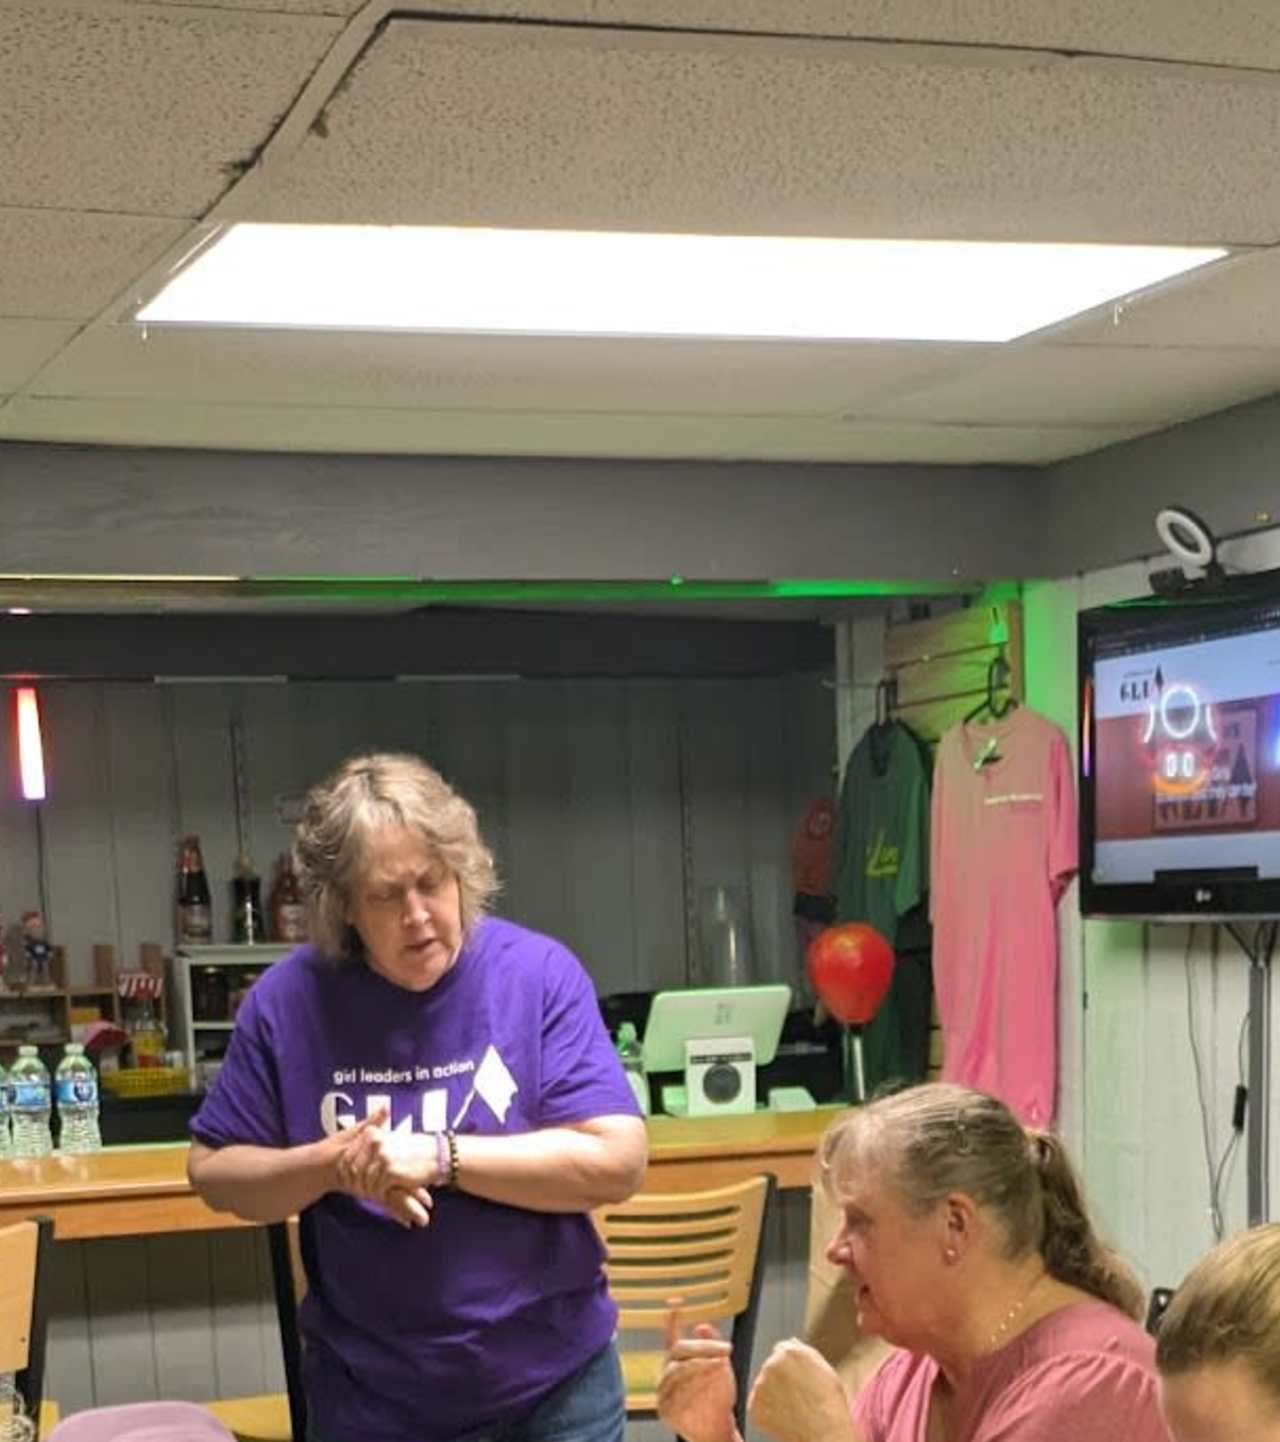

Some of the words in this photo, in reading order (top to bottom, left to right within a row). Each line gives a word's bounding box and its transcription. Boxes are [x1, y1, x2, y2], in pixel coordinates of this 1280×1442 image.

[333, 1070, 356, 1085] girl
[360, 1068, 412, 1083] leaders
[415, 1066, 430, 1080] in
[433, 1060, 474, 1078] action
